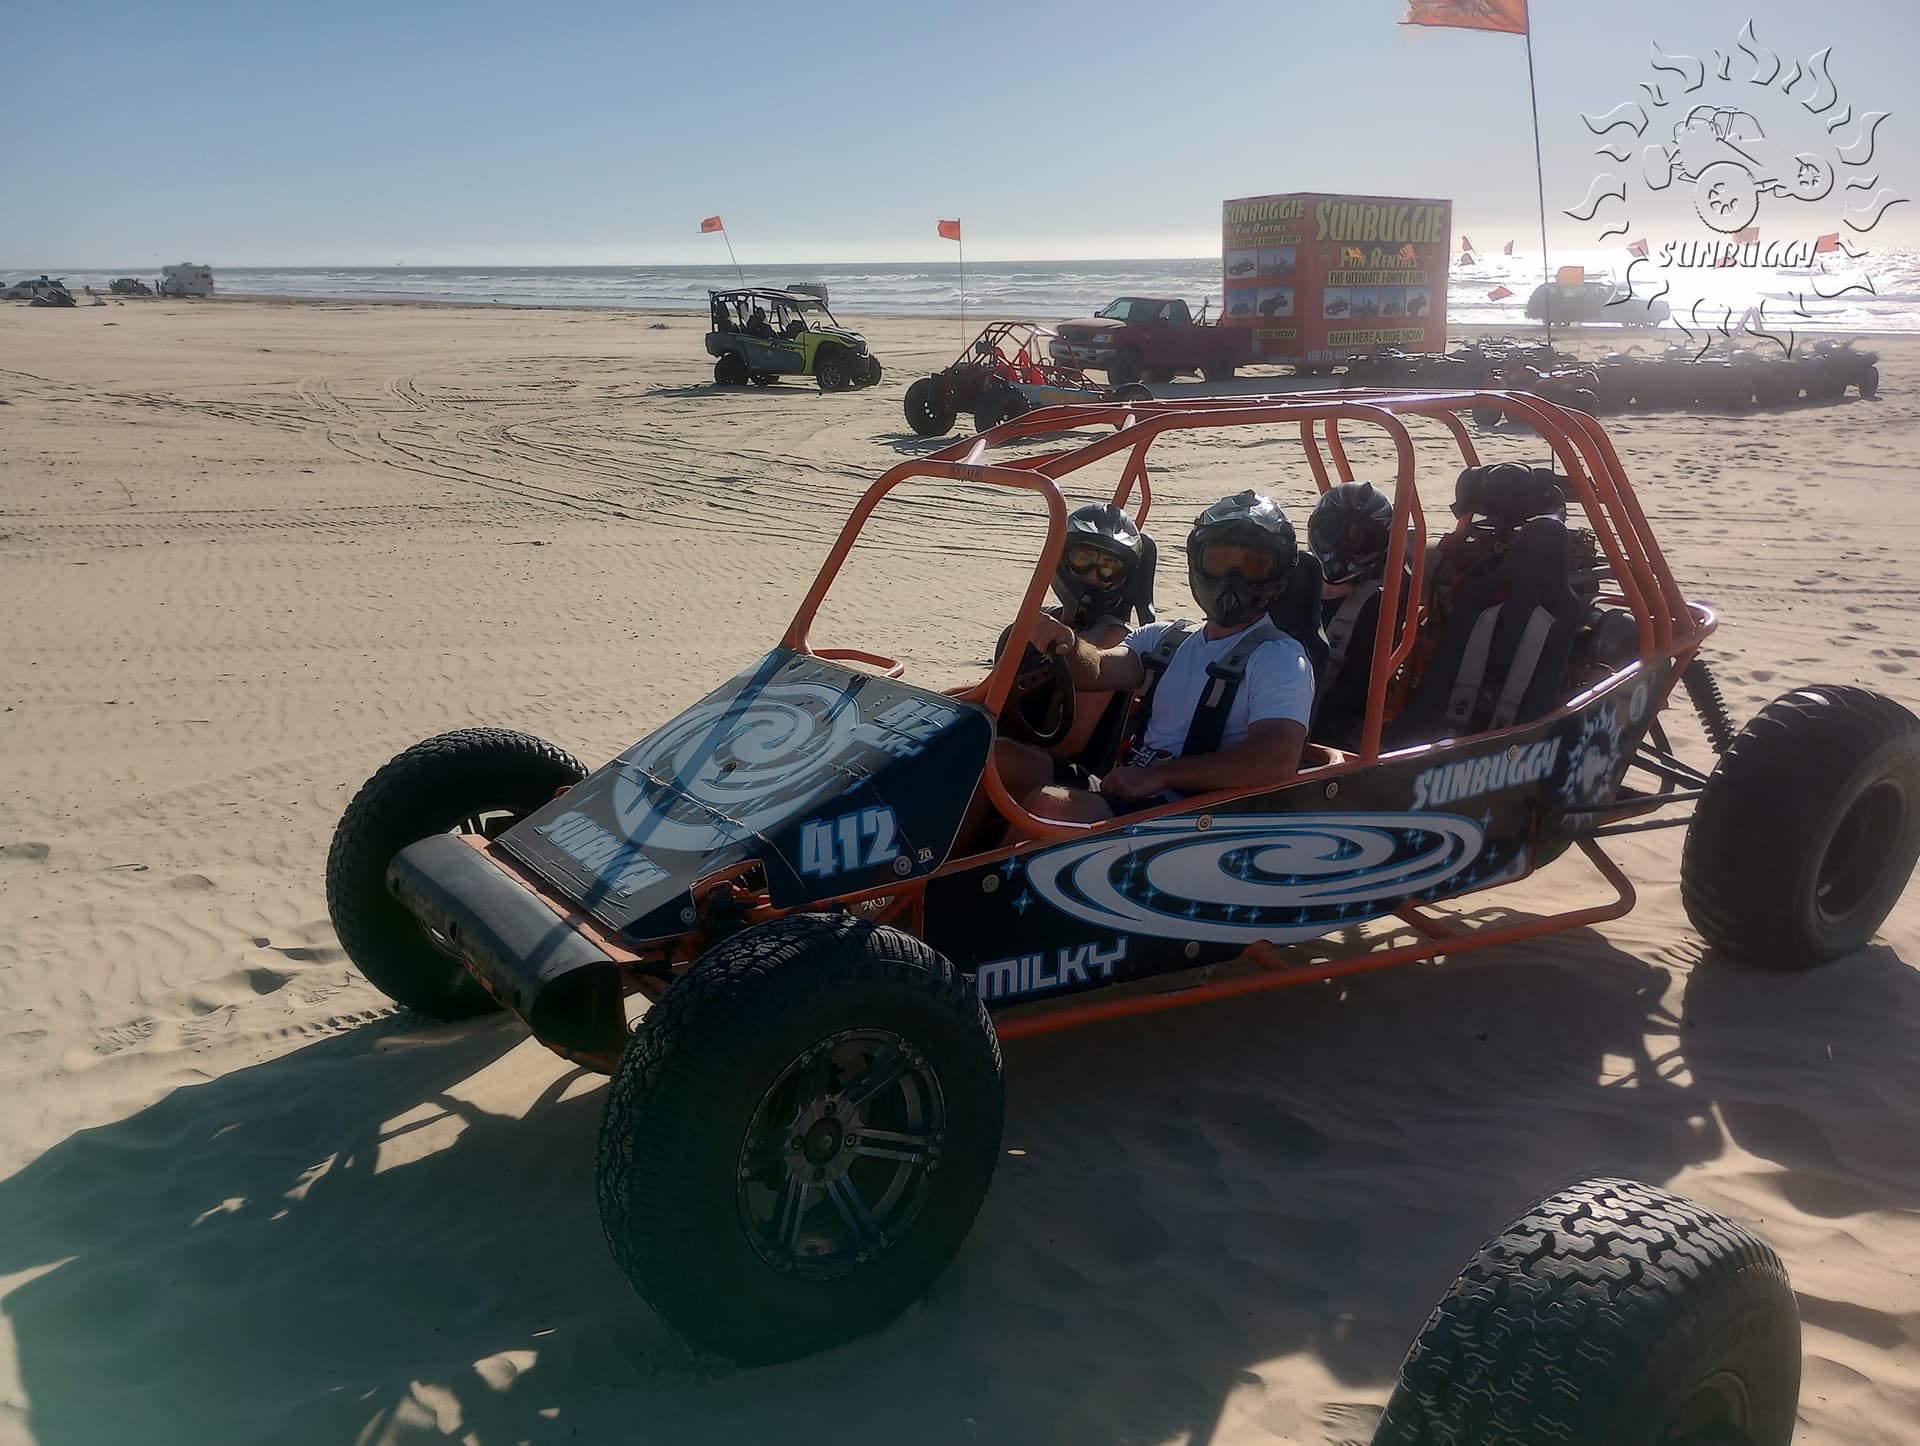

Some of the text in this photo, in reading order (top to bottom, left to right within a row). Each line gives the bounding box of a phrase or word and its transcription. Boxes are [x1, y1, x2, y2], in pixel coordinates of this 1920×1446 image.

[1315, 199, 1445, 242] SUNBUGGIE
[1330, 271, 1344, 284] THE
[1329, 331, 1351, 345] RENT
[1353, 331, 1374, 343] HERE
[1384, 329, 1401, 342] RIDE
[1402, 328, 1423, 341] NOW
[1408, 734, 1562, 811] SUNBUGGY
[800, 806, 899, 877] 412
[977, 936, 1128, 1001] MILKY
